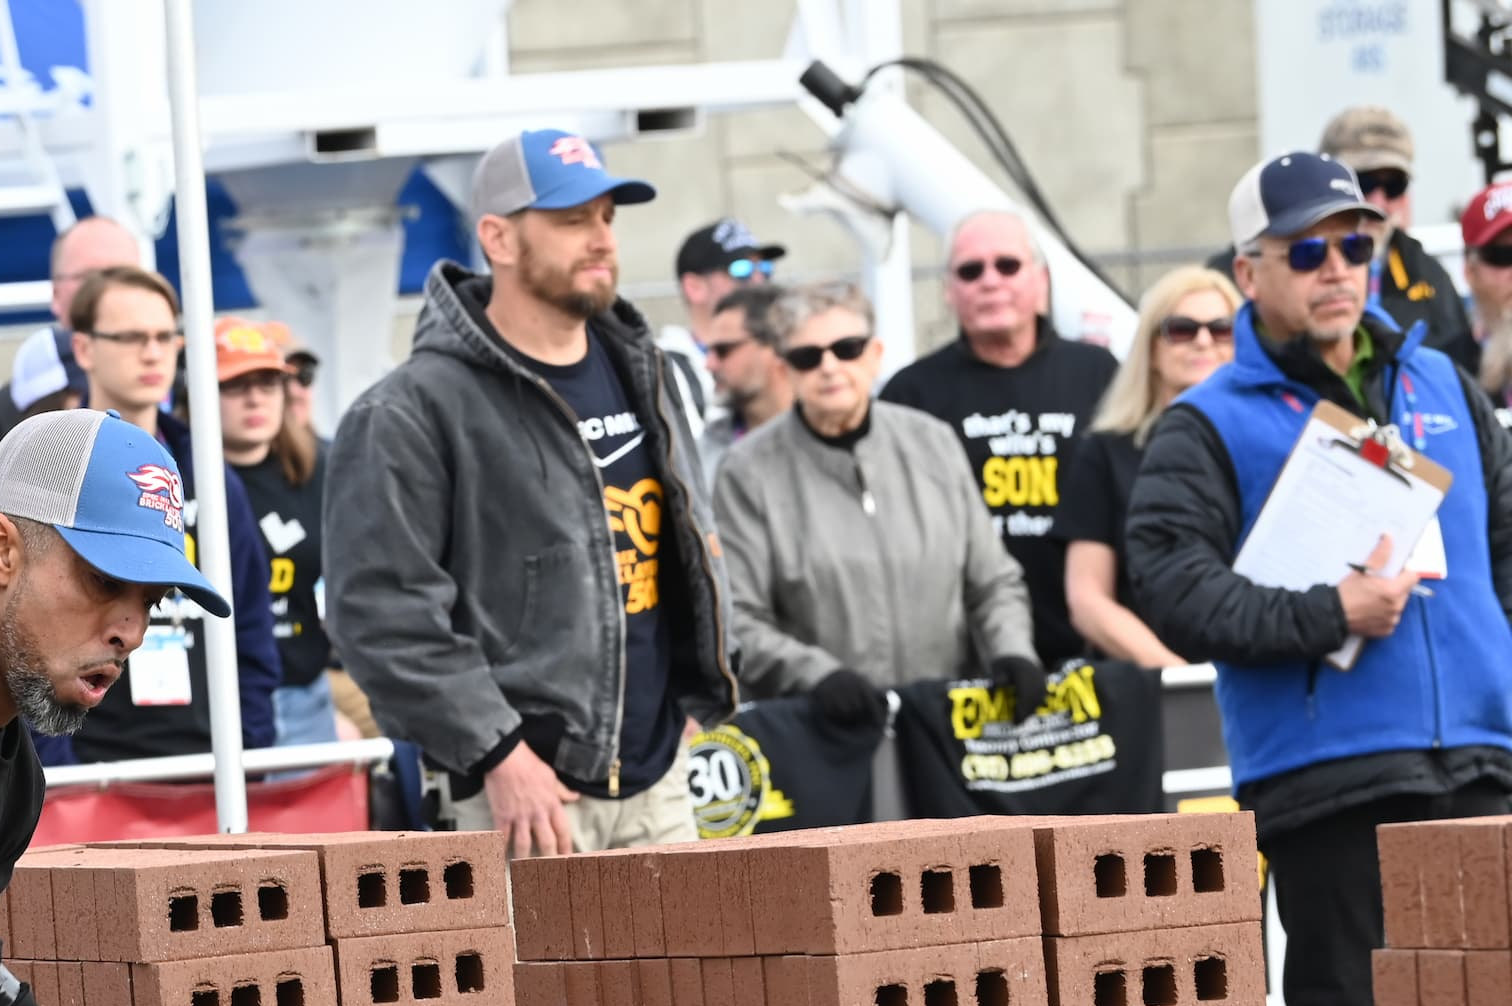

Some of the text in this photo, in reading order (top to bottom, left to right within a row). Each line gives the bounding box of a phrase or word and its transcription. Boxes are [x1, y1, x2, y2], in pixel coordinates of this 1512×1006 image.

[1038, 412, 1076, 438] my
[982, 456, 1059, 507] SON
[687, 750, 743, 808] 30
